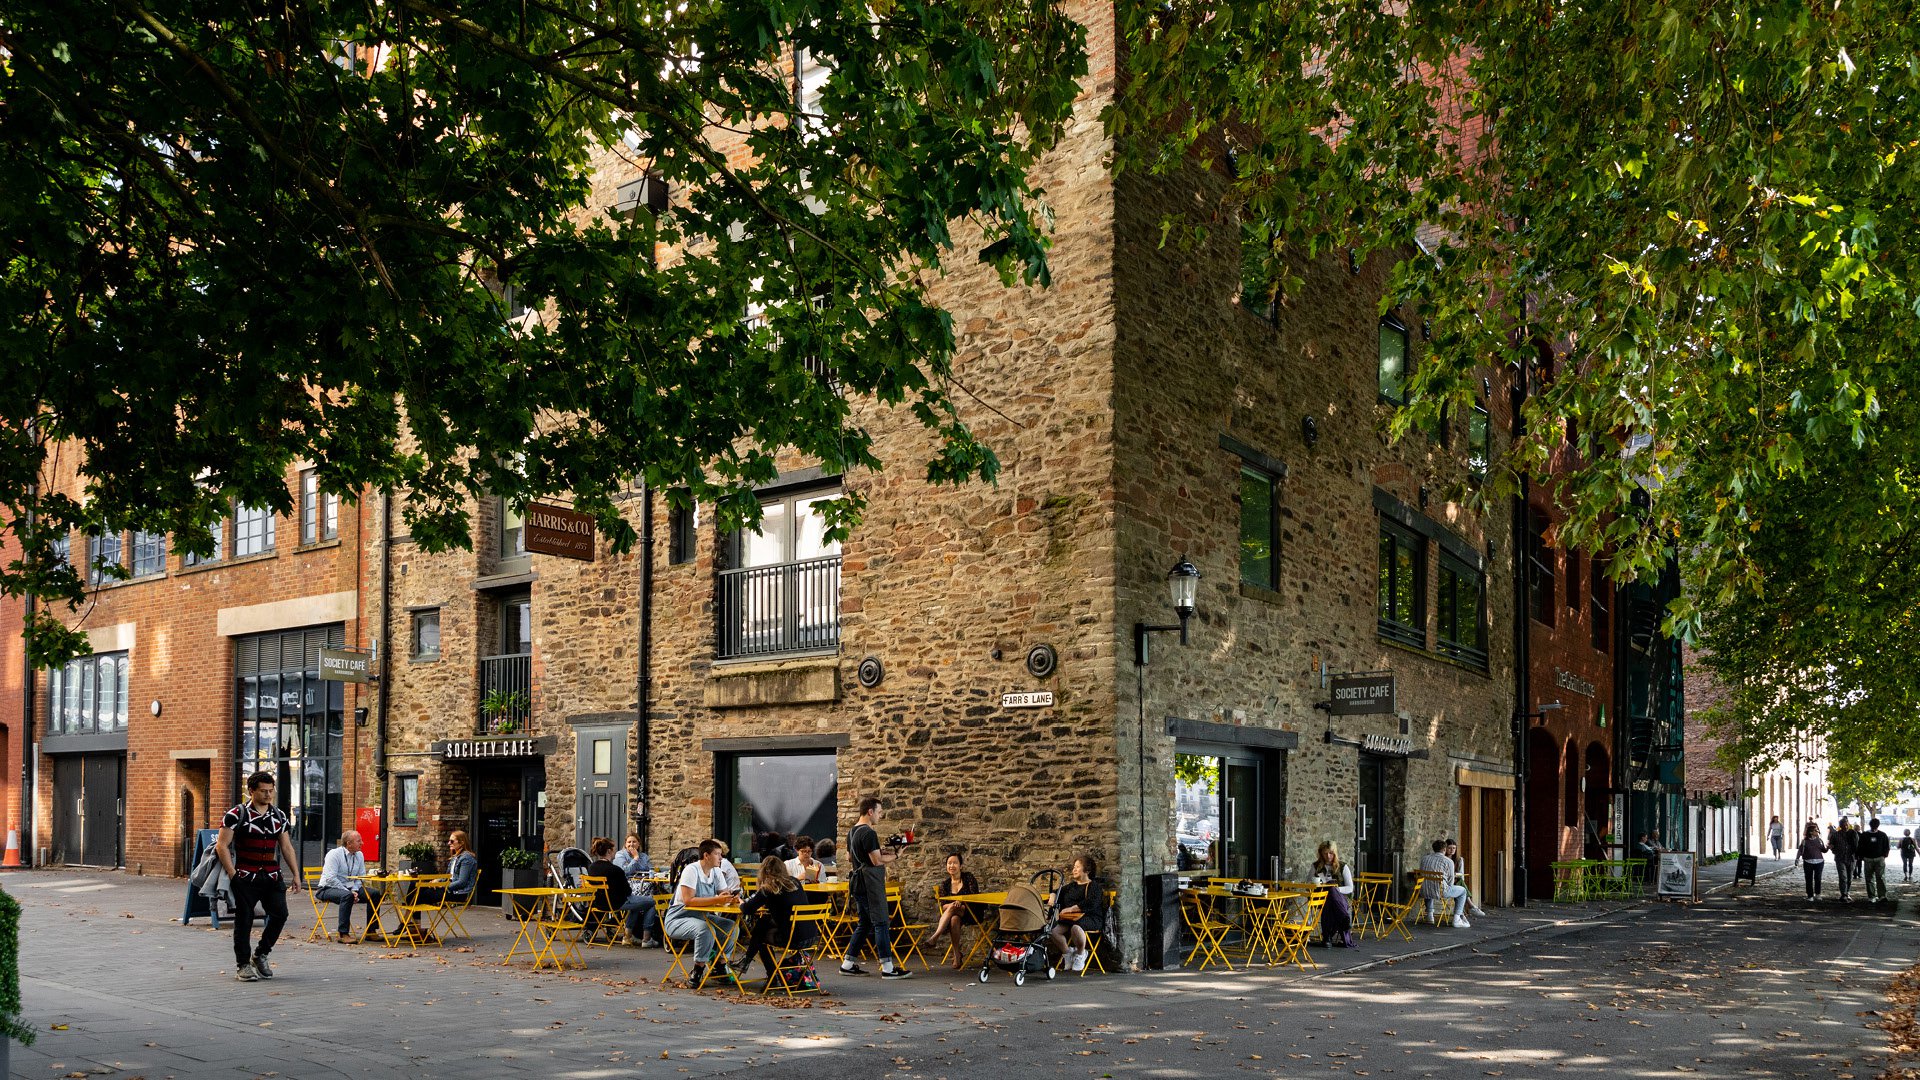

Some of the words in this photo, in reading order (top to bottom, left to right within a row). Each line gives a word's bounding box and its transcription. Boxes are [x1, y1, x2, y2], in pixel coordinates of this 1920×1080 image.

[533, 533, 571, 548] Established
[324, 658, 349, 669] SOCIETY
[1335, 687, 1368, 700] SOCIETY
[1370, 683, 1390, 698] CAFÉ
[1004, 695, 1029, 705] FARR'S
[1032, 694, 1050, 704] LANE
[447, 742, 496, 758] SOCIETY
